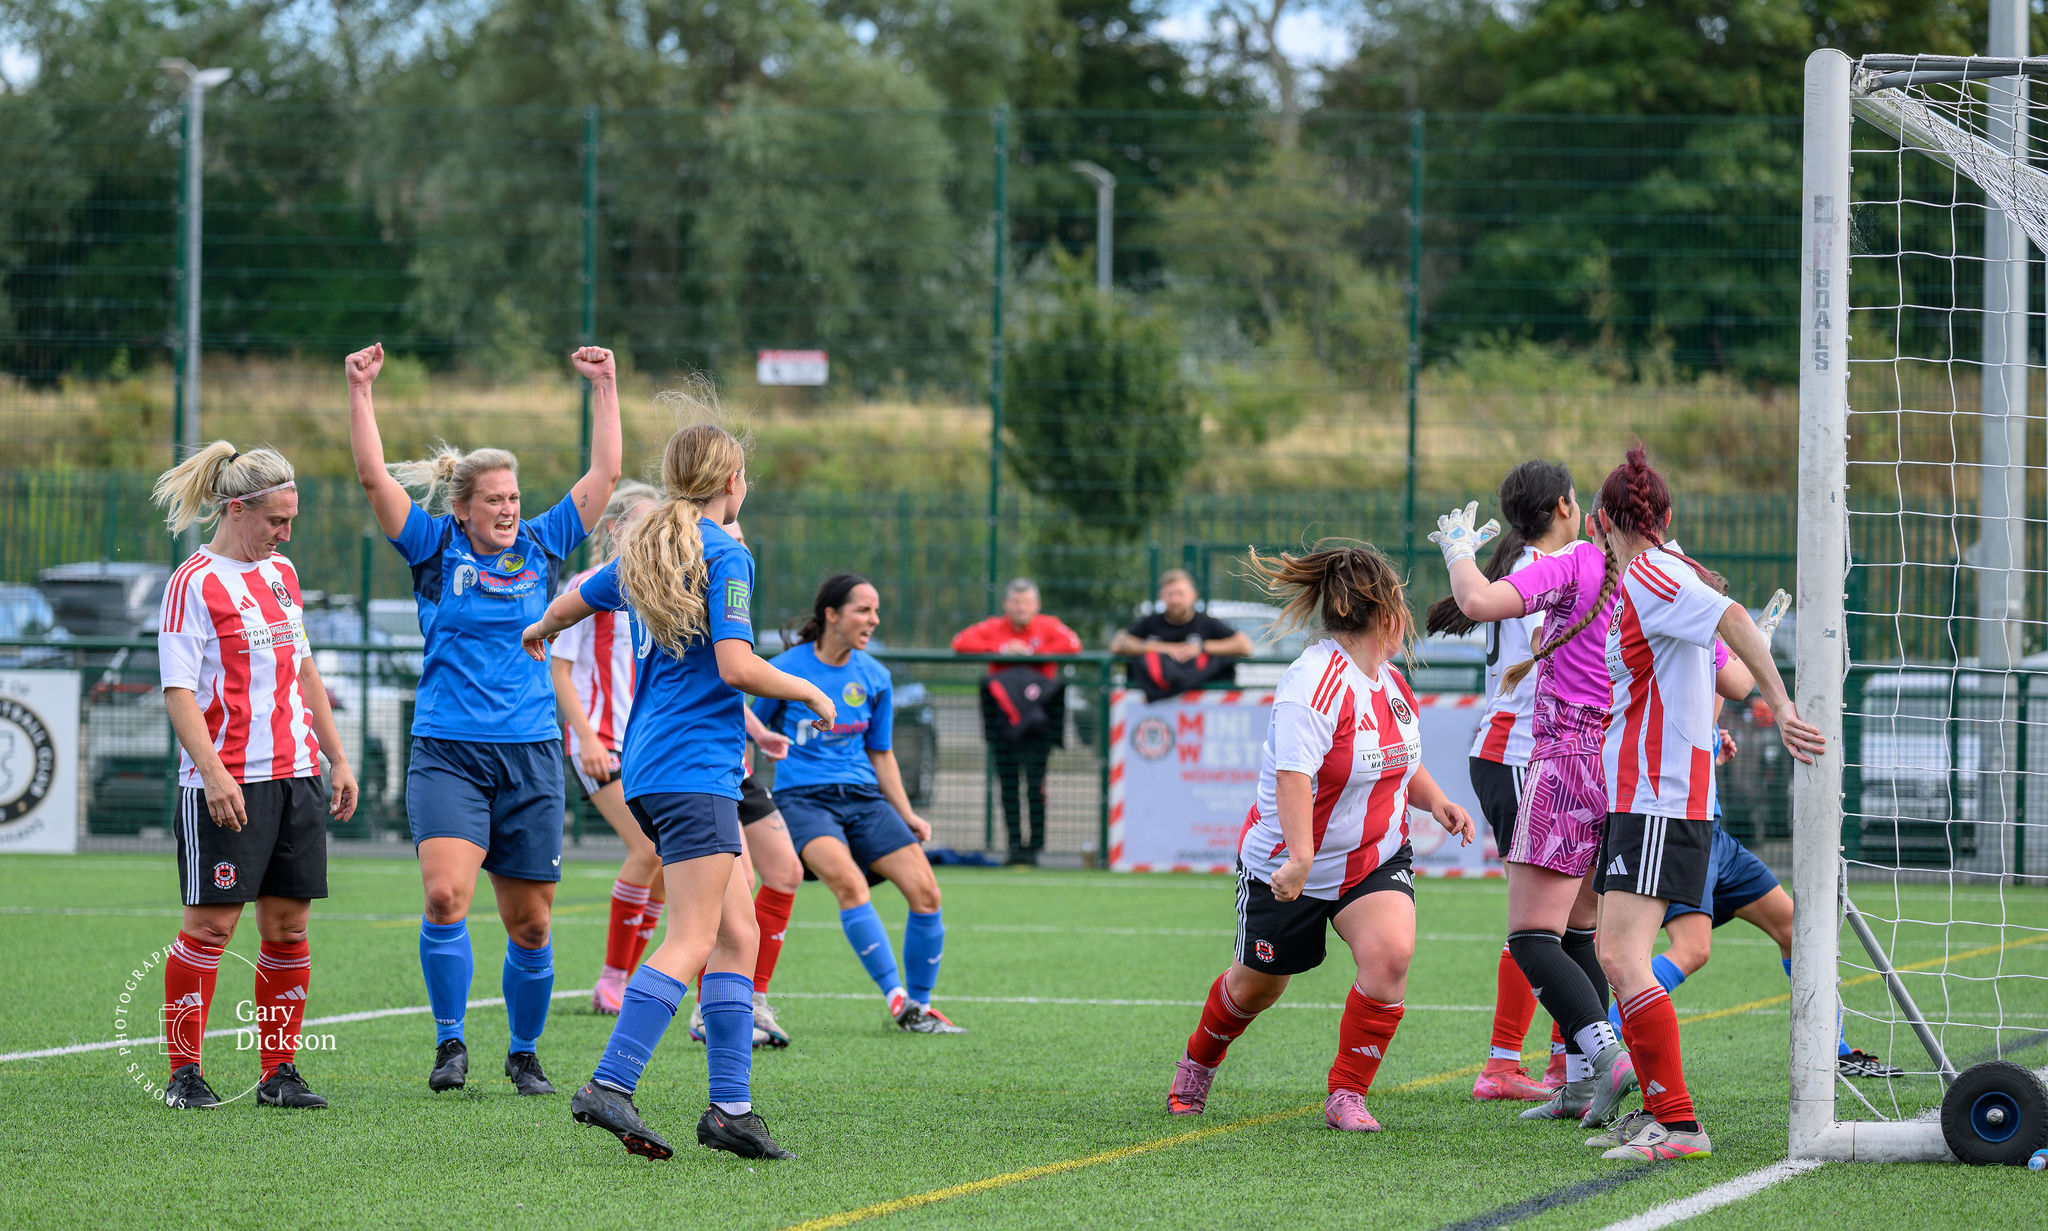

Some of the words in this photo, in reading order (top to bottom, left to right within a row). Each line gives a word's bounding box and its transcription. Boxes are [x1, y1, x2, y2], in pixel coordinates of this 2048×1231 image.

[480, 569, 538, 587] Penrith
[241, 629, 269, 640] LYONS
[1177, 711, 1250, 738] MINI
[1362, 750, 1386, 761] LYONS
[1371, 751, 1418, 769] MANAGEMENT
